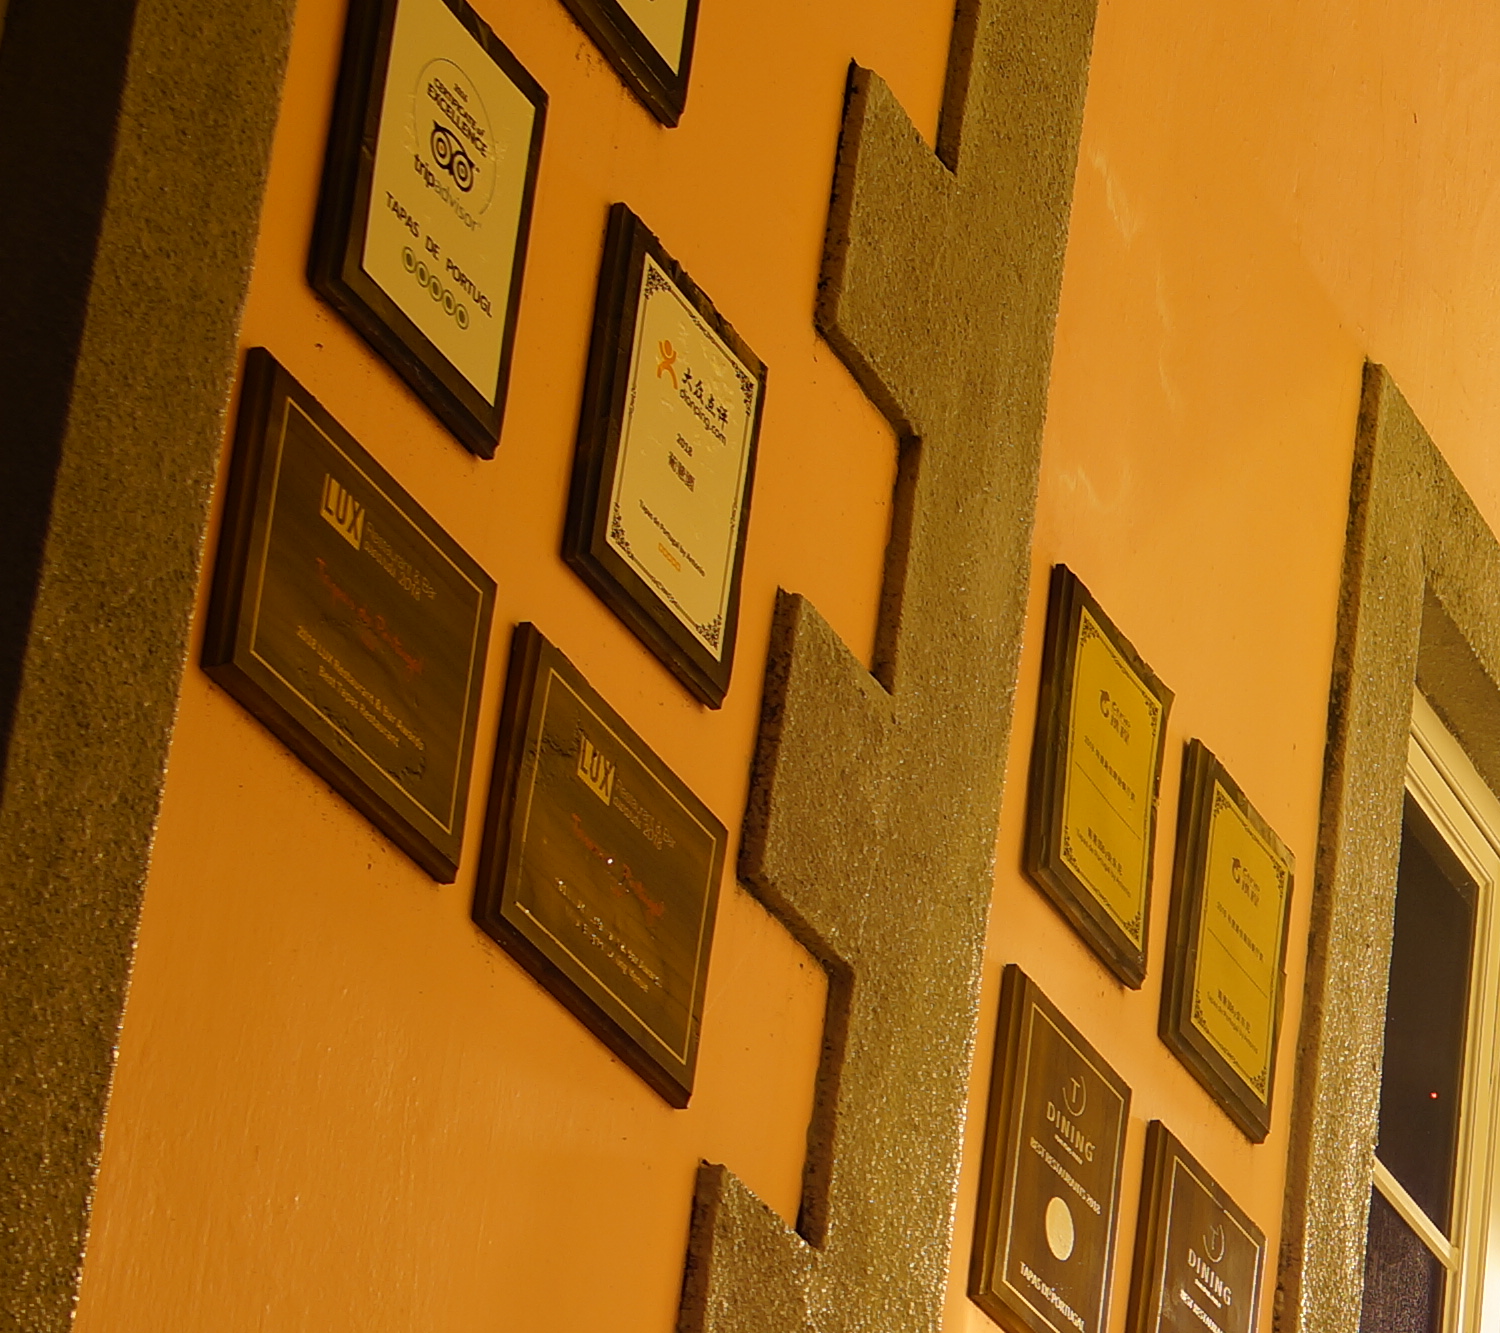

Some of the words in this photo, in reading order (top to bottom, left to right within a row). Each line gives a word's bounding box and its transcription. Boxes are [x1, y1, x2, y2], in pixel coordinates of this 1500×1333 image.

[426, 81, 488, 160] EXCELLENCE
[433, 74, 476, 131] CERTIFICATE
[384, 189, 420, 241] TAPAS
[424, 232, 440, 262] DE
[412, 149, 477, 240] tripadvisor
[325, 476, 362, 541] LUX
[580, 736, 612, 797] LUX
[1045, 1098, 1096, 1166] DINING
[1019, 1260, 1042, 1293] TAPAS
[1187, 1246, 1232, 1308] DINING
